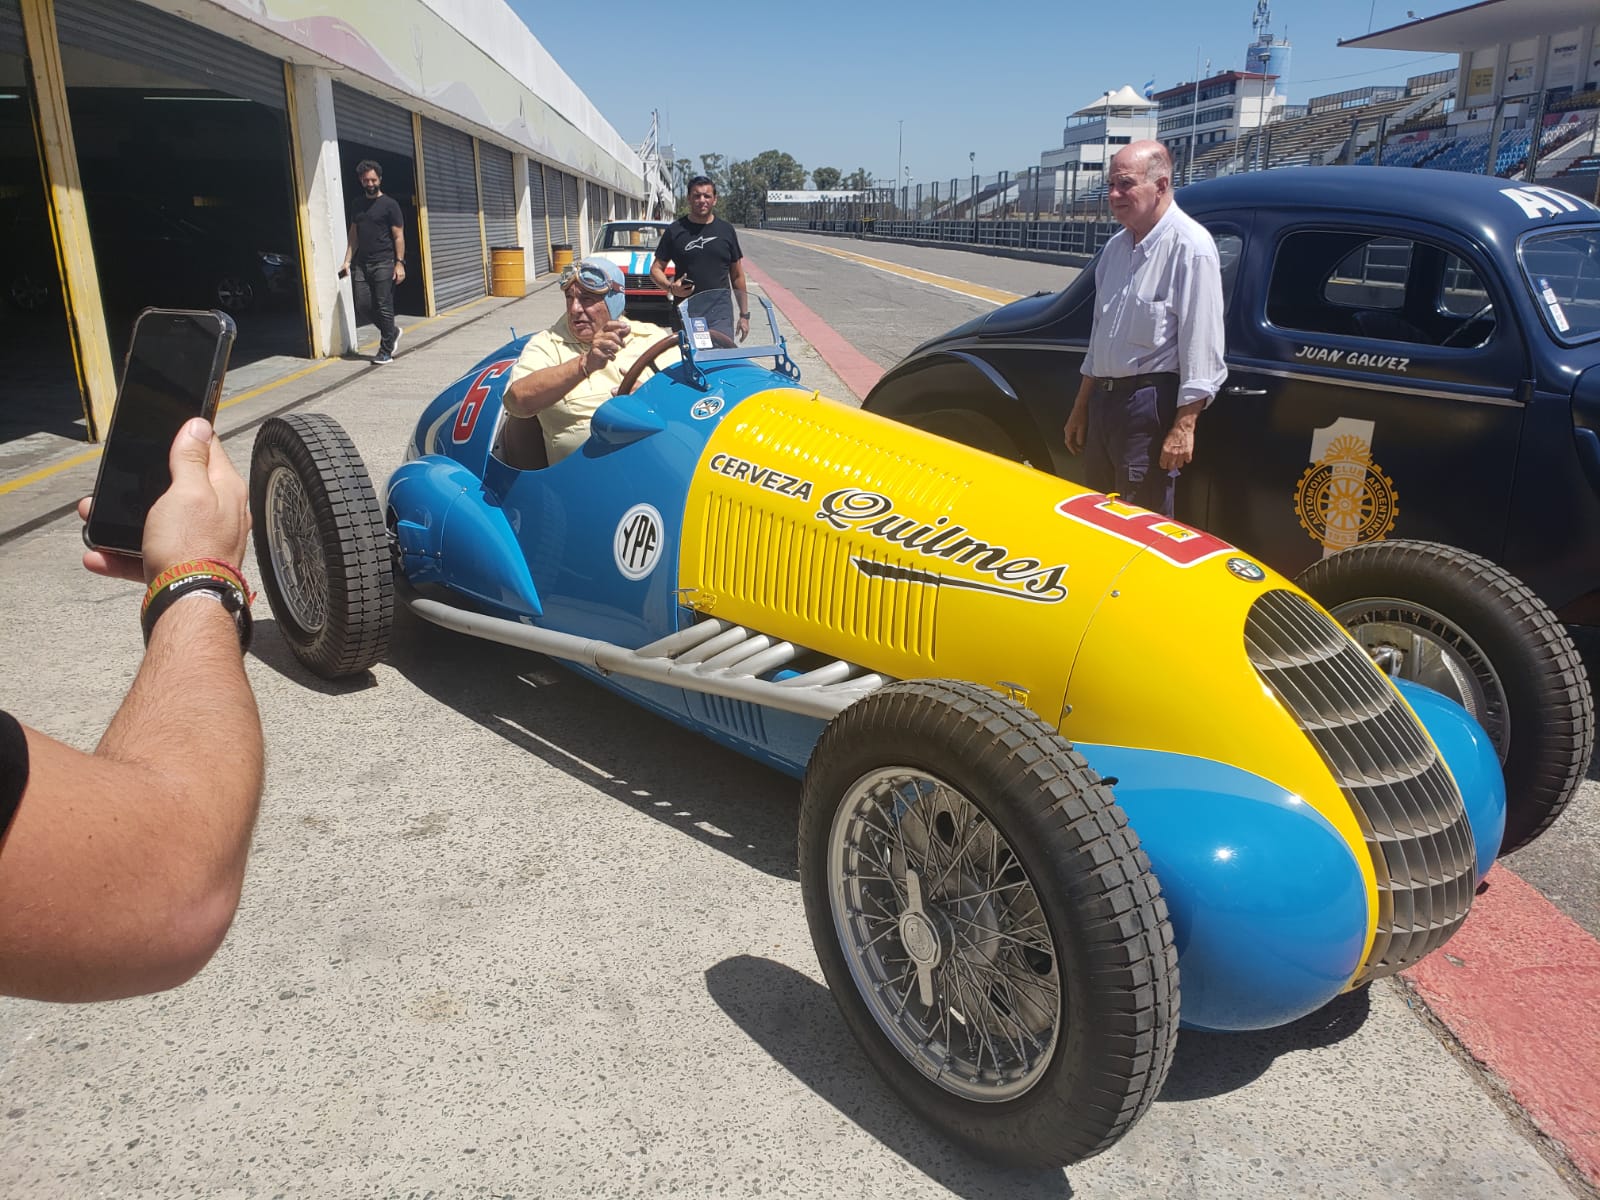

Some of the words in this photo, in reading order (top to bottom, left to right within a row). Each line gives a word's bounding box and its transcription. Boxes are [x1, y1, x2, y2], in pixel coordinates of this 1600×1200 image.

[1499, 185, 1600, 219] AT
[1295, 345, 1344, 363] JUAN
[1346, 352, 1410, 372] GALVEZ
[452, 358, 518, 444] 6
[709, 454, 814, 501] CERVEZA
[1305, 470, 1332, 528] AUTOMOVIL
[1334, 465, 1365, 477] CLUB
[1366, 477, 1388, 536] ARGENTINO
[1309, 416, 1375, 560] 1
[622, 514, 657, 569] YPF
[816, 489, 1068, 602] Quilmes
